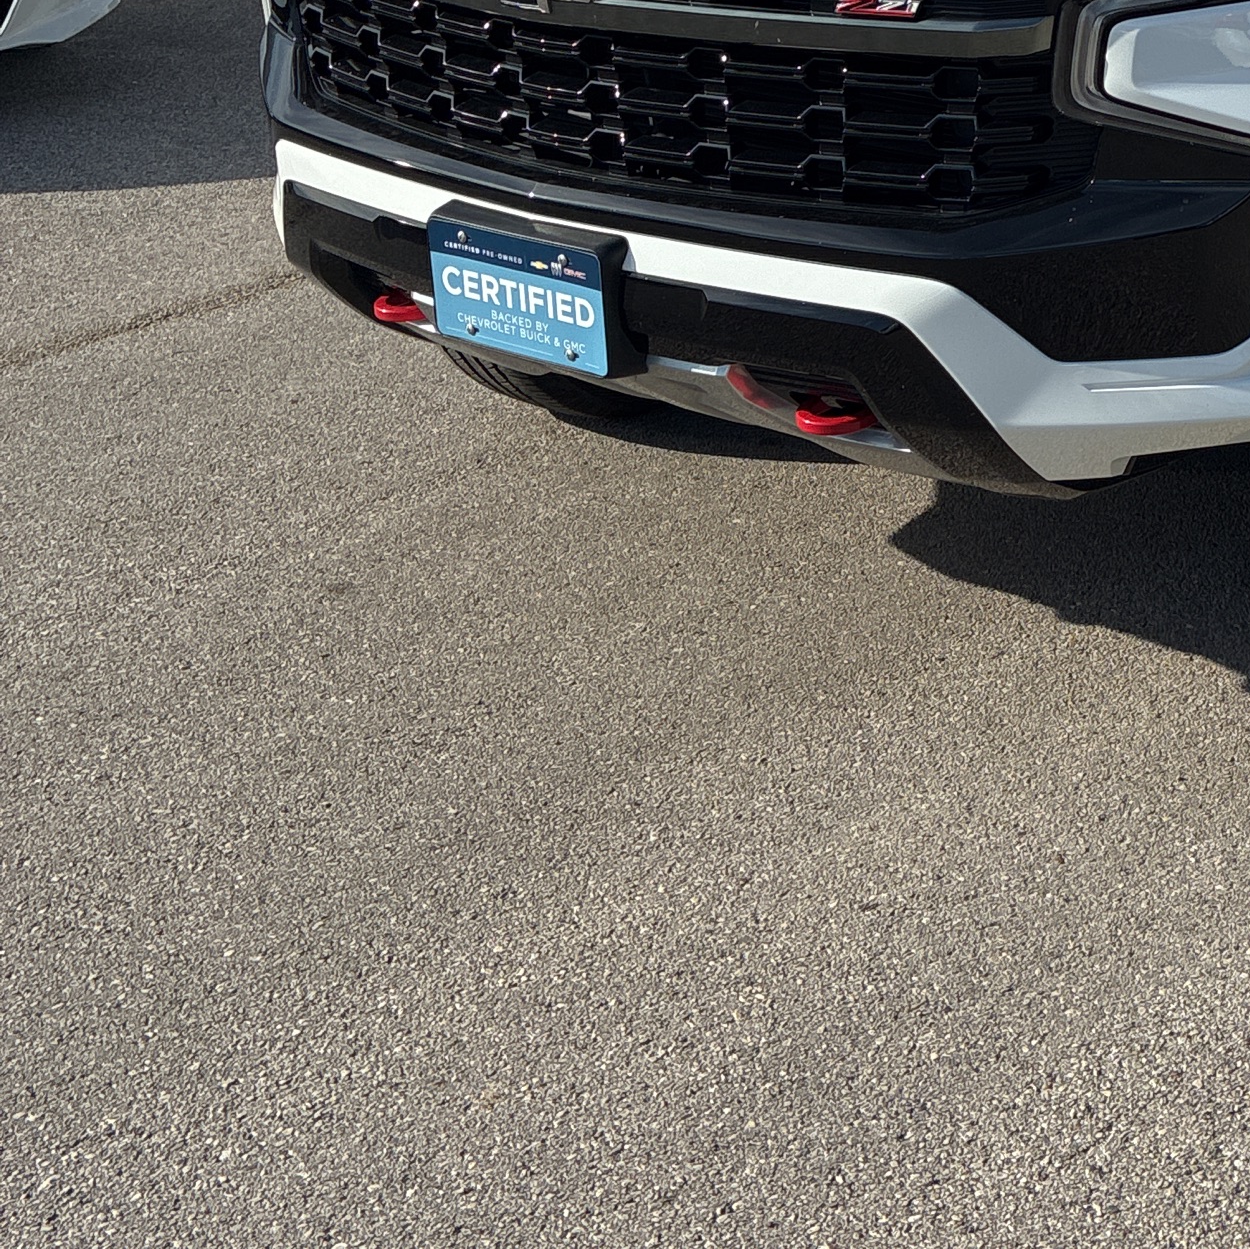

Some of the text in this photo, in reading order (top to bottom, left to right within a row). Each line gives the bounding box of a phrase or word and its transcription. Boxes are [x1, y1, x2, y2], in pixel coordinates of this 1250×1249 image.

[444, 241, 523, 265] CERTIFIED PRE-OWNED
[441, 266, 595, 329] CERTIFIED
[457, 312, 586, 354] CHEVROLET BUICK & GMC
[491, 310, 549, 333] BACKED BY
